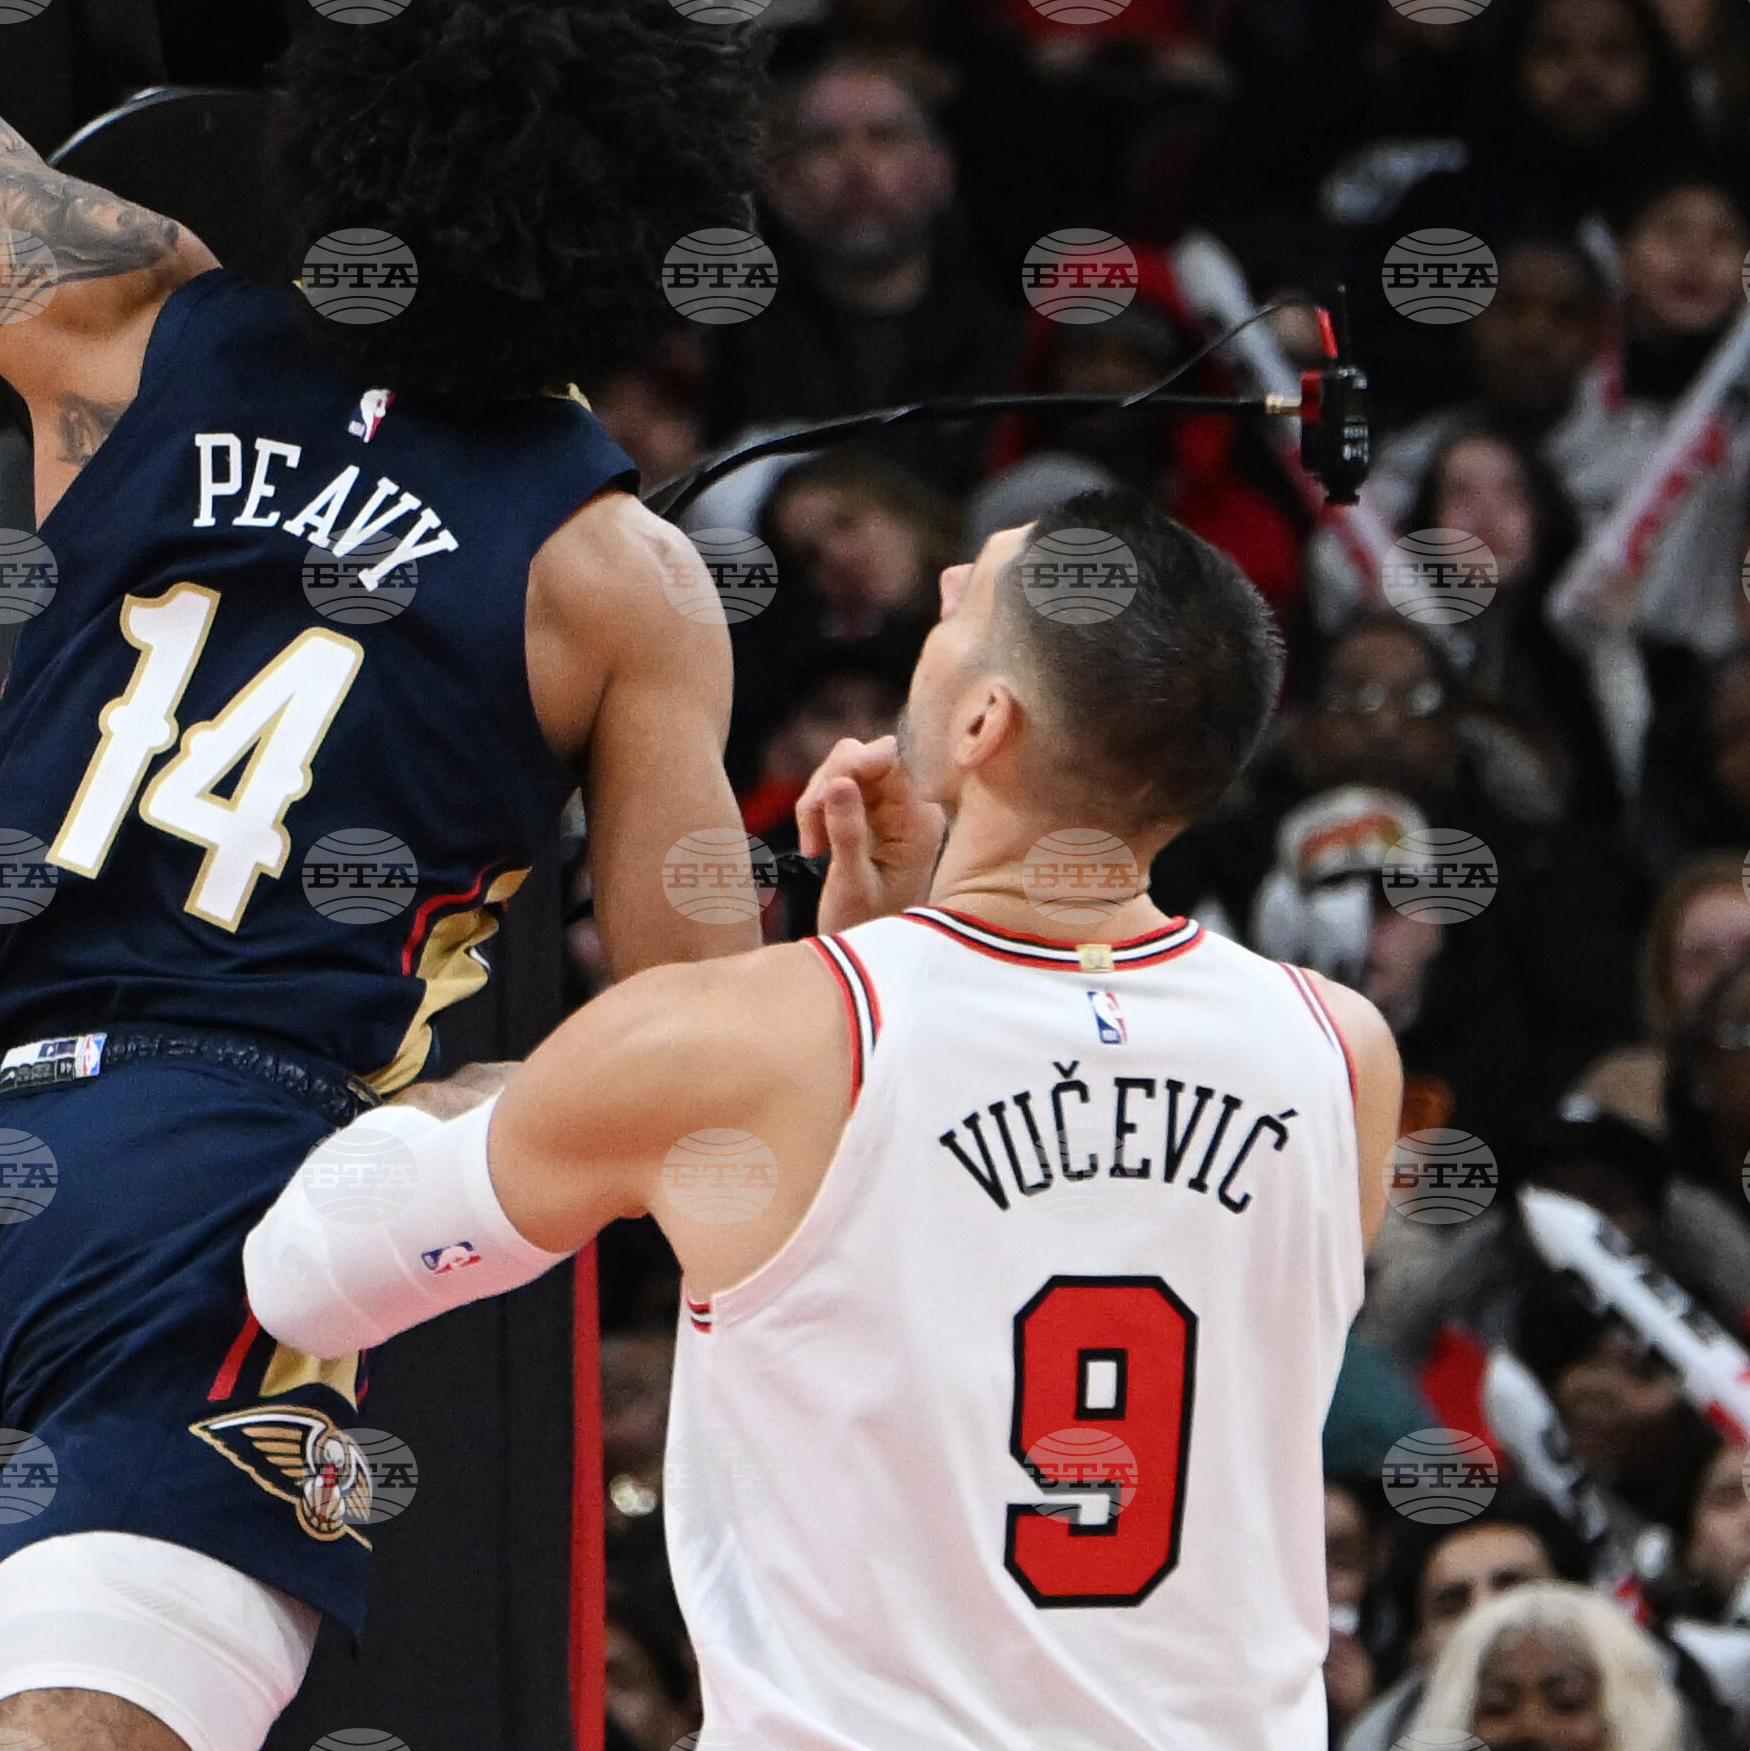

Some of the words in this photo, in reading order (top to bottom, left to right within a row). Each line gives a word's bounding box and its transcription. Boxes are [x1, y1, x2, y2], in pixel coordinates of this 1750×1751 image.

[191, 432, 458, 593] PEAVY
[45, 581, 365, 934] 14
[939, 1061, 1297, 1215] VUČEVIĆ
[1003, 1274, 1198, 1609] 9
